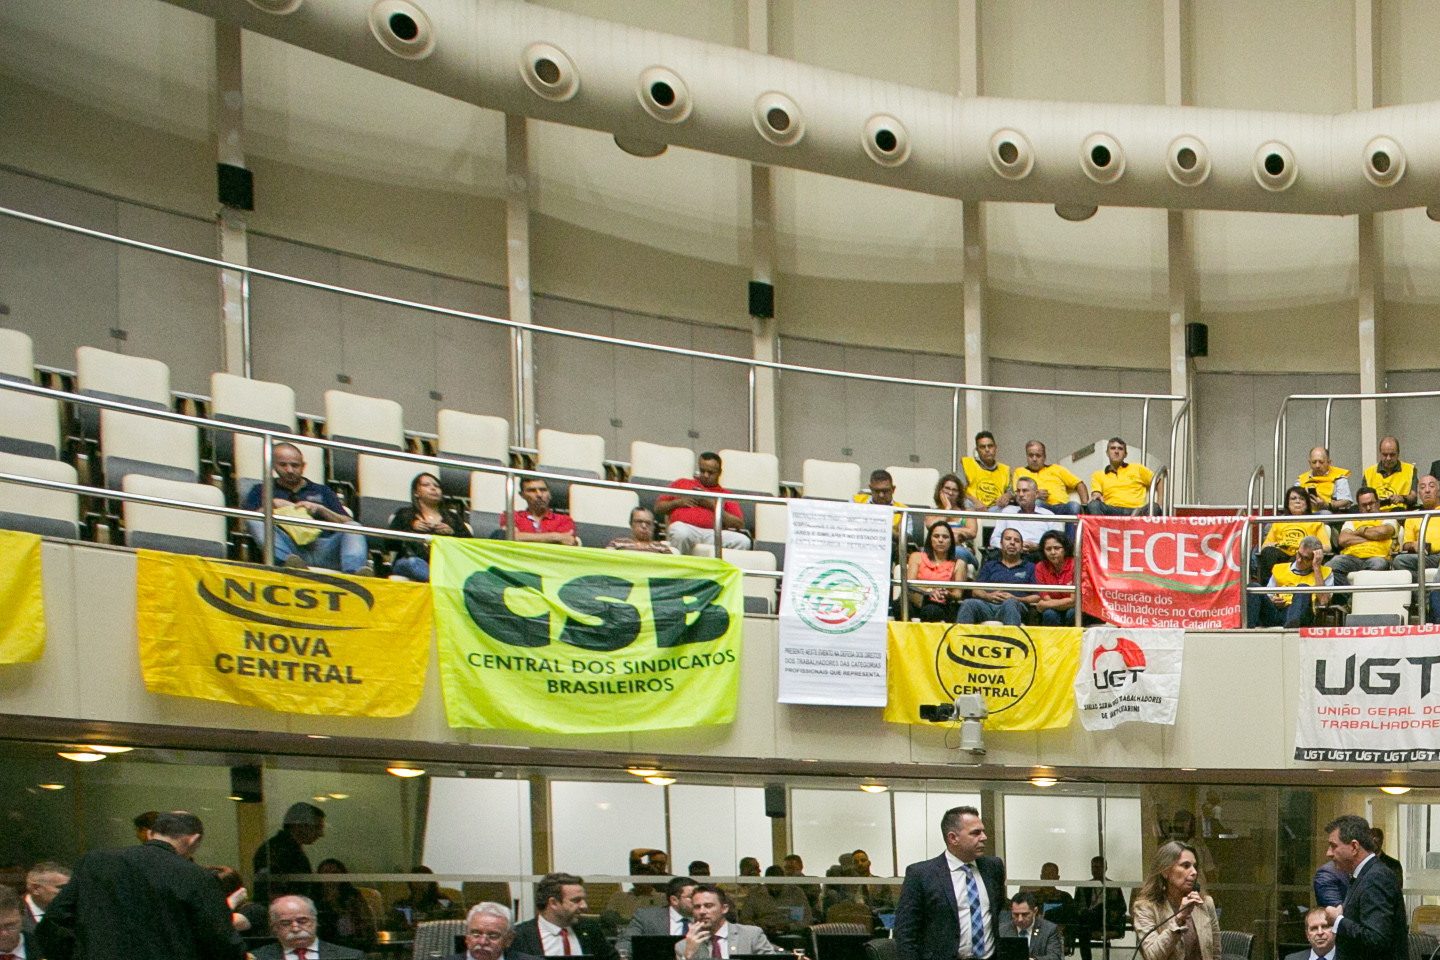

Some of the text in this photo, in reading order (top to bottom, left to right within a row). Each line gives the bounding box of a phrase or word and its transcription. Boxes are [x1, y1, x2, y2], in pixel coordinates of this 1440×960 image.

[223, 577, 350, 612] NCST
[1100, 587, 1173, 605] Federação dos
[462, 565, 731, 652] CSB
[1172, 607, 1186, 617] no
[1188, 605, 1233, 618] Comércio
[1101, 607, 1222, 629] Estado de Santa Catarina
[1308, 627, 1330, 636] UGT
[1335, 626, 1359, 636] UGT
[1362, 626, 1386, 635] UGT
[1389, 625, 1414, 634] UGT
[1417, 624, 1440, 633] UGT
[243, 629, 331, 658] NOVA
[961, 644, 1015, 659] NCST
[213, 652, 363, 685] CENTRAL
[467, 648, 736, 676] CENTRAL DOS SINDICATOS
[797, 658, 838, 667] TRABALHADORES
[851, 660, 881, 669] CATEGORIAS
[785, 667, 828, 675] PROFISSIONAIS
[967, 672, 1006, 685] NOVA
[547, 677, 675, 695] BRASILEIROS
[953, 684, 1018, 698] CENTRAL
[1317, 703, 1361, 716] UNIÃO
[1367, 705, 1416, 716] GERAL
[1303, 749, 1325, 760] UGT
[1328, 750, 1353, 761] UGT
[1355, 750, 1381, 762] UGT
[1383, 751, 1407, 762] UGT
[1410, 750, 1435, 761] UGT
